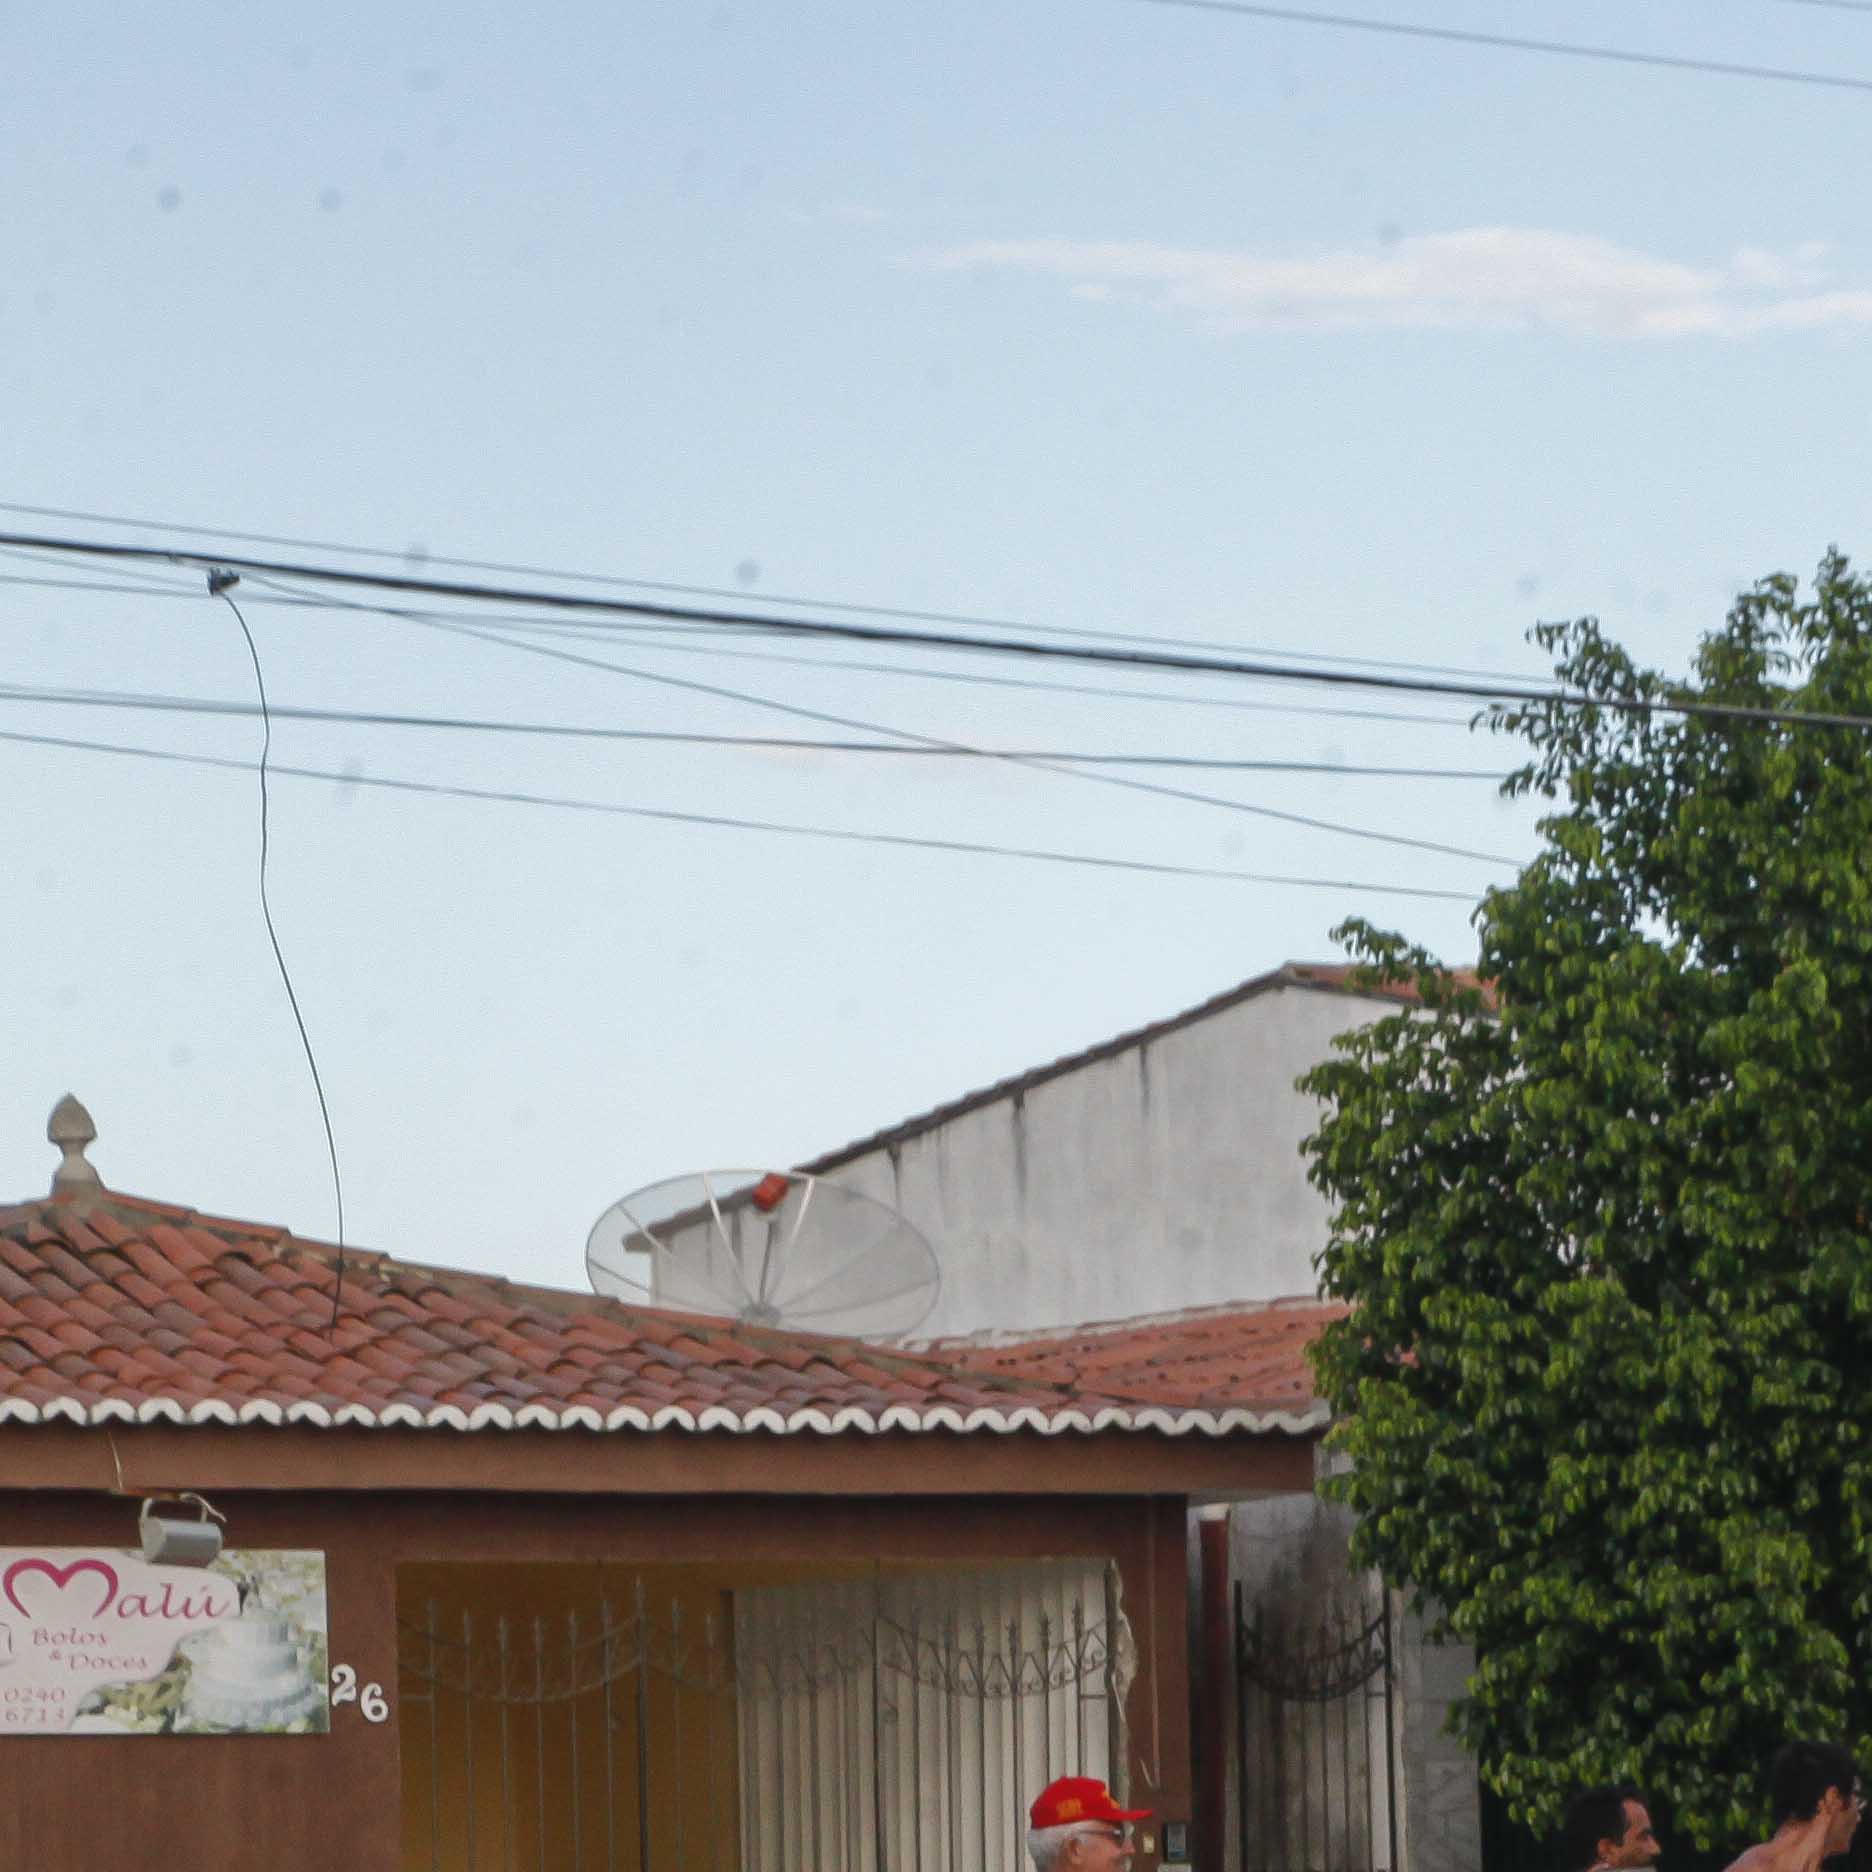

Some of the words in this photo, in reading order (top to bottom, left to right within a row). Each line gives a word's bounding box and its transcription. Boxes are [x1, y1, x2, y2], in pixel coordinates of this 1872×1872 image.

[32, 1628, 108, 1646] Bolos
[66, 1654, 147, 1670] Doces
[331, 1664, 389, 1722] 26
